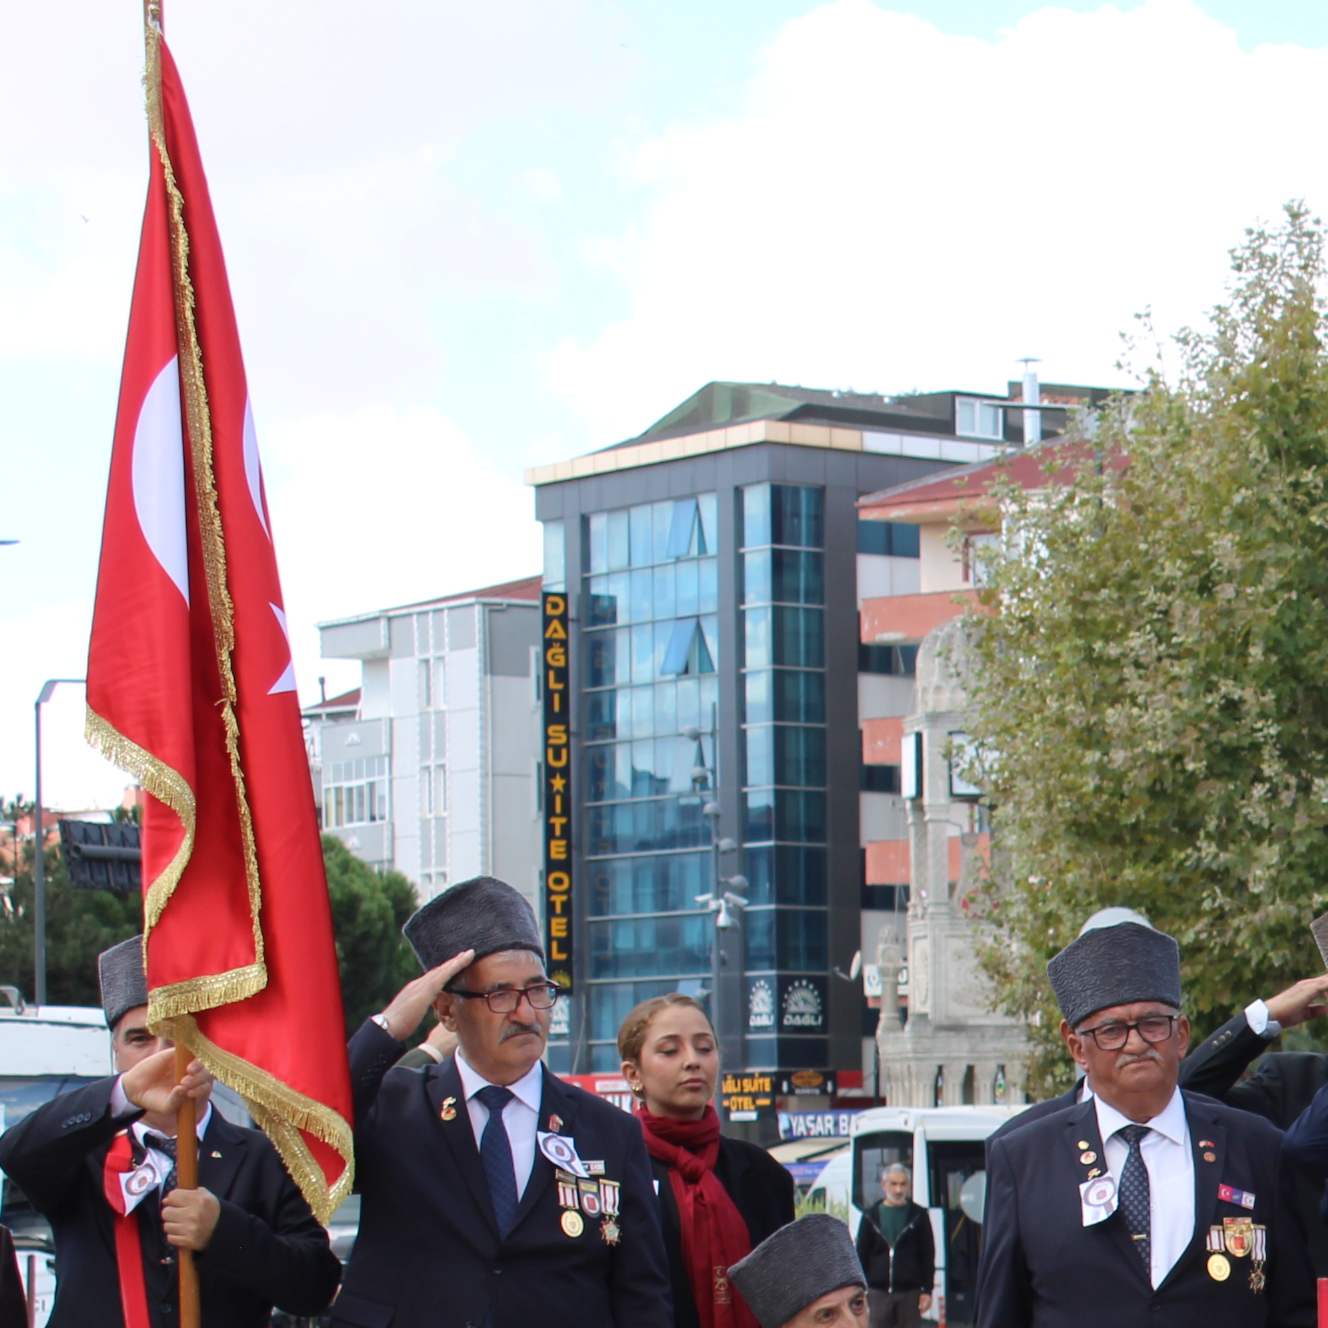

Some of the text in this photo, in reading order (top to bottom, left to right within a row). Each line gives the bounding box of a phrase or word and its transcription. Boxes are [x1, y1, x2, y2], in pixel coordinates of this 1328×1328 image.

[544, 595, 567, 713] DAĞLI
[547, 872, 570, 961] OTEL
[782, 1013, 823, 1027] DAĞLI
[730, 1096, 756, 1112] OTEL
